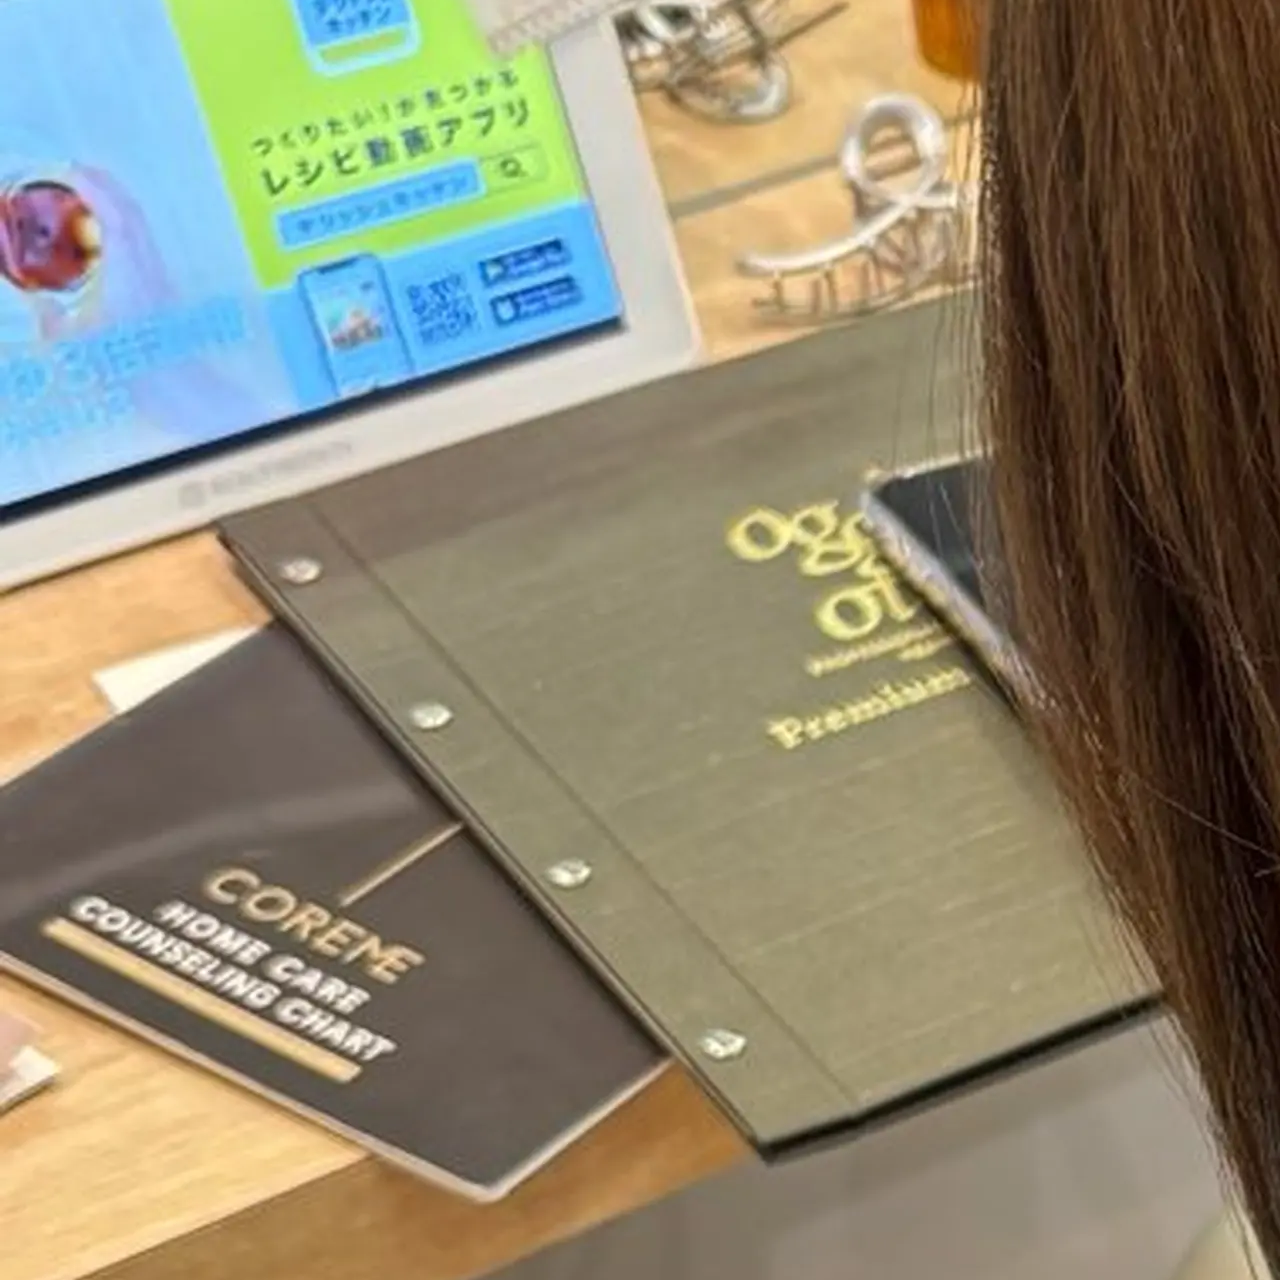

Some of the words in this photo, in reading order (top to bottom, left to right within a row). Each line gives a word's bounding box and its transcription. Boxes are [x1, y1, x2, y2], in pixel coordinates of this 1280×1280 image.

[261, 96, 530, 198] レシピ動画アプリ
[766, 667, 973, 750] Premium
[70, 895, 282, 1010] COUNSELING
[274, 997, 398, 1062] CHART
[155, 899, 272, 966] HOME
[263, 954, 371, 1015] CARE
[205, 866, 426, 986] COREME
